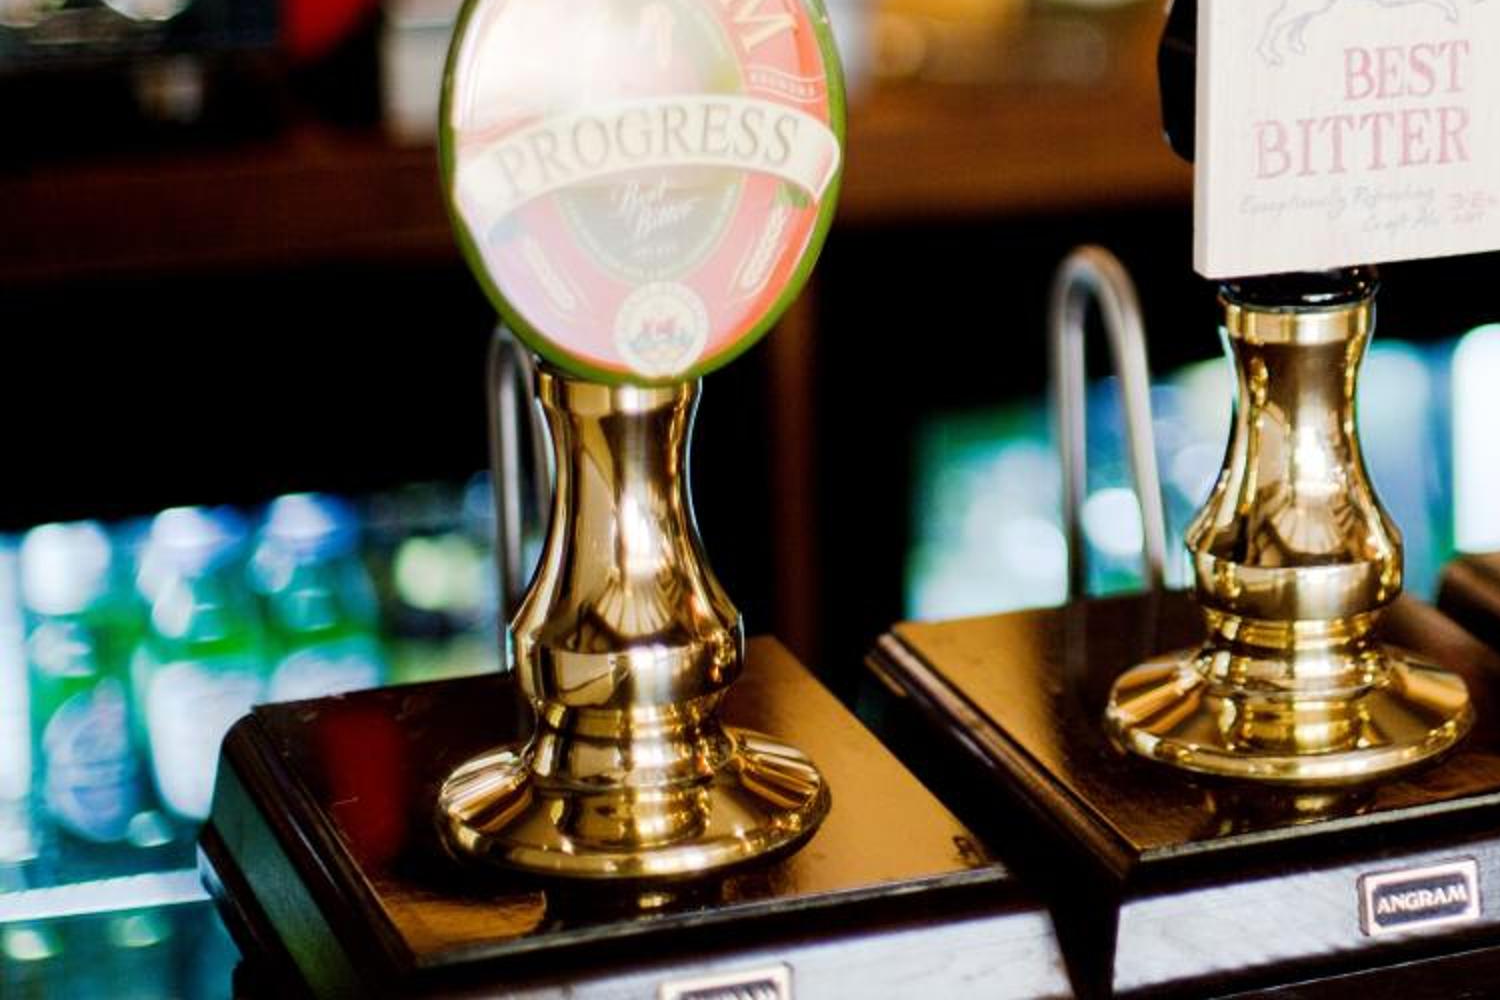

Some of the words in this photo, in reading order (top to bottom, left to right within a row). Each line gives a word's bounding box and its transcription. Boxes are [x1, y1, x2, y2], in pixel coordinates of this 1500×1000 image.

[1343, 39, 1472, 102] BEST
[495, 103, 799, 197] PROGRESS
[1253, 105, 1472, 181] BITTER
[1376, 883, 1468, 915] ANGRAM
